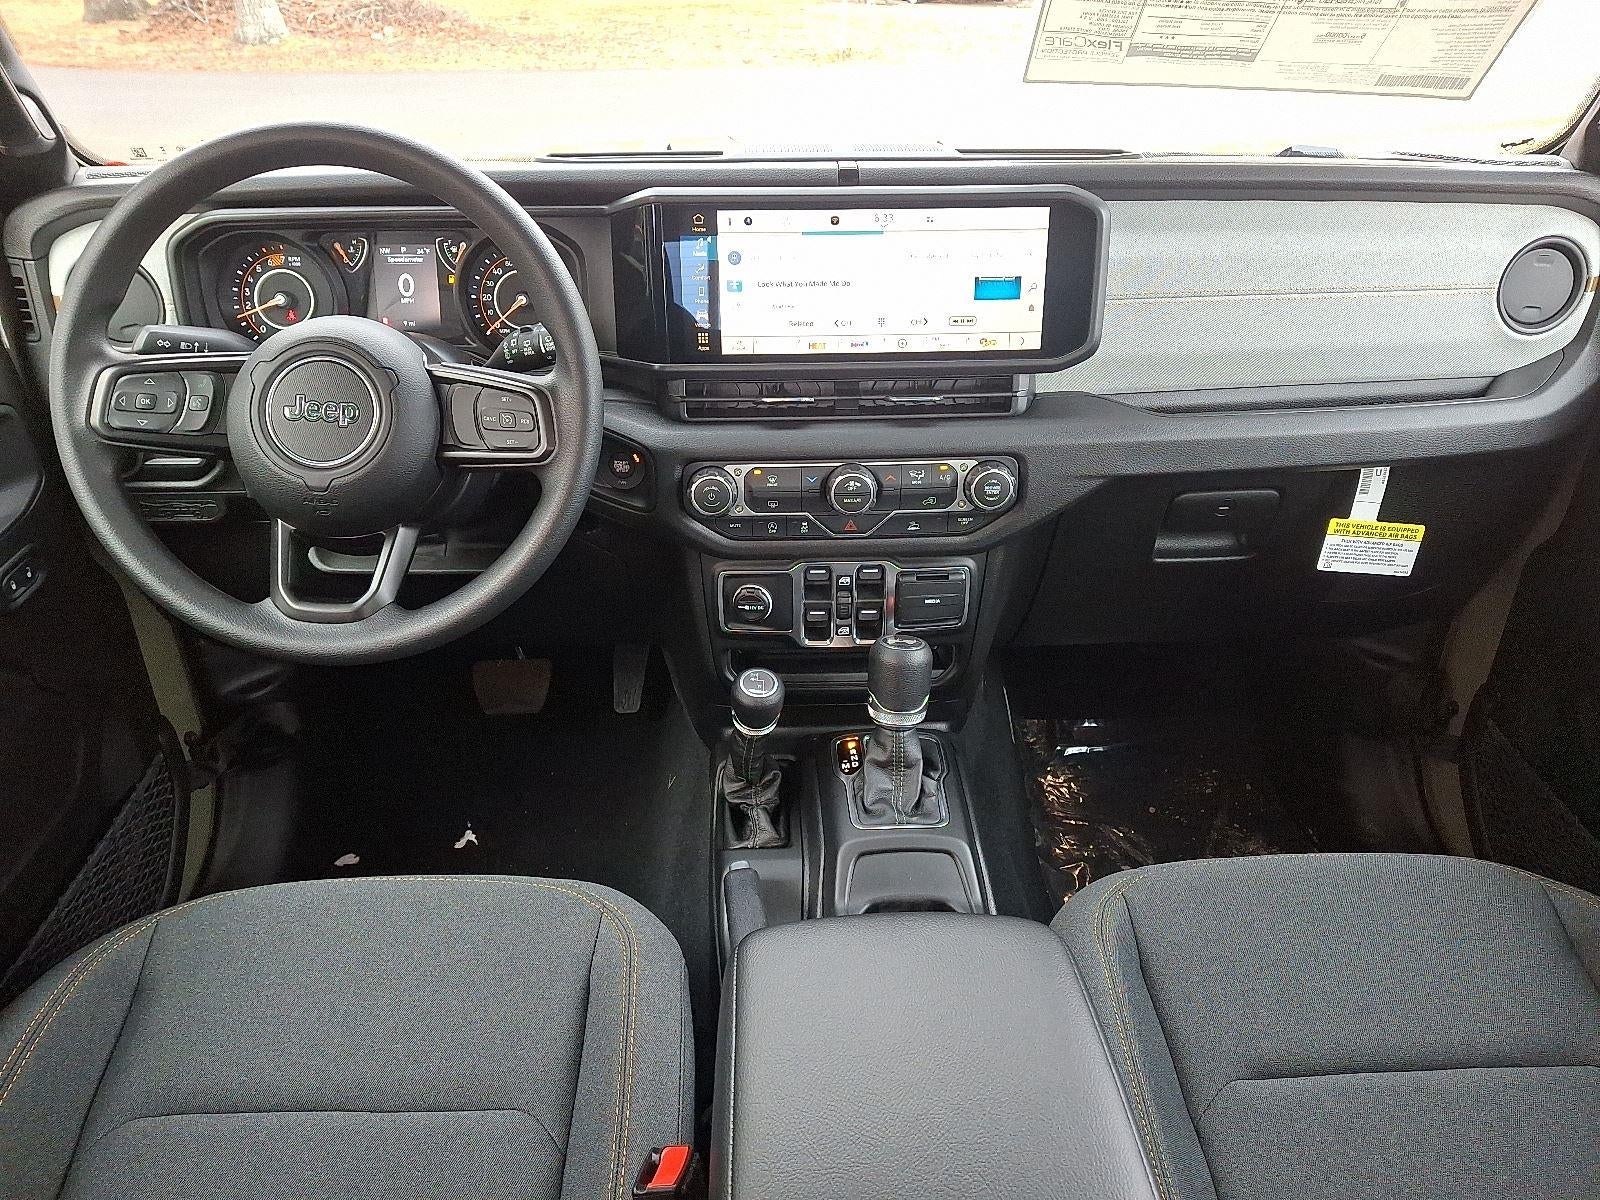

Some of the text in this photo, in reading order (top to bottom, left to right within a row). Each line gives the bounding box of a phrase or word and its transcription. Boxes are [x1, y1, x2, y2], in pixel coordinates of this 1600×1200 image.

[400, 246, 407, 254] P
[492, 267, 502, 275] 40
[247, 275, 253, 283] 4
[398, 273, 415, 297] 0
[244, 287, 250, 295] 3
[482, 293, 493, 301] 20
[245, 302, 252, 310] 2
[260, 325, 267, 333] 0
[140, 398, 151, 406] OK
[283, 394, 361, 428] Jeep
[1351, 523, 1379, 531] VEHICLE
[1387, 526, 1420, 534] EQUIPPED
[841, 762, 851, 770] M
